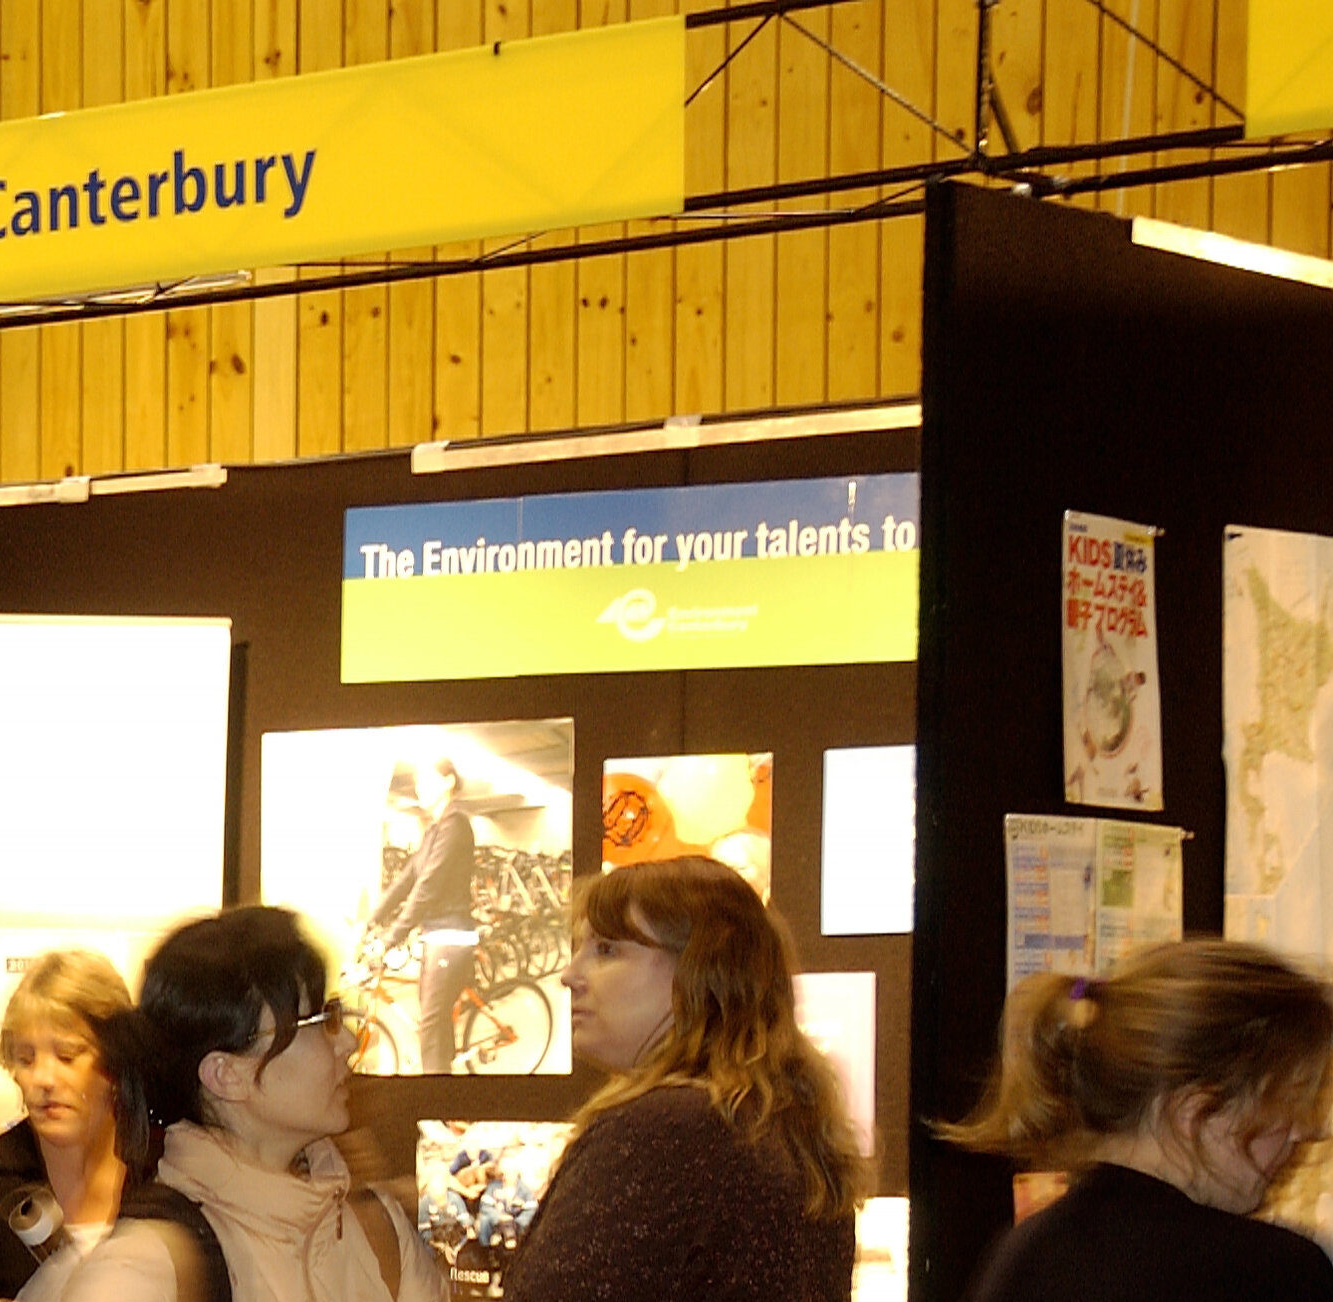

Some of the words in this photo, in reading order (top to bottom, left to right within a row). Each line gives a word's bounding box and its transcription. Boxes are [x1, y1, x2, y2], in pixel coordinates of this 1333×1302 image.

[360, 544, 415, 580] The
[422, 530, 614, 577] Environment
[623, 526, 668, 566] for
[675, 528, 749, 571] your
[755, 516, 871, 558] talents
[882, 514, 917, 552] to
